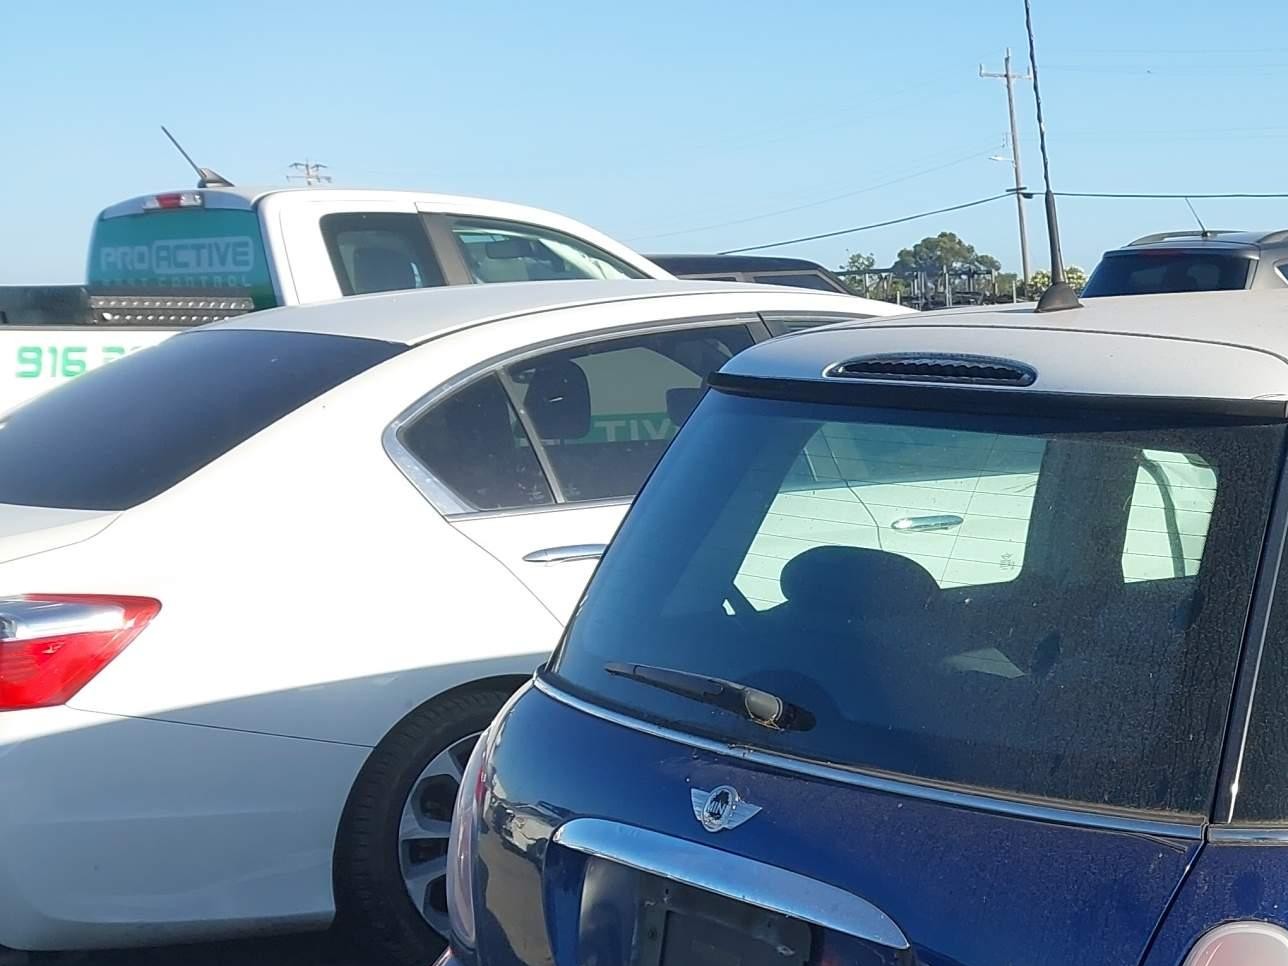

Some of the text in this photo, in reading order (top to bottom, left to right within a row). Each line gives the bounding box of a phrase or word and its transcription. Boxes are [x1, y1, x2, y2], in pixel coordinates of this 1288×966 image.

[158, 275, 253, 288] CONTROL
[16, 346, 87, 378] 916
[593, 418, 680, 442] TIV
